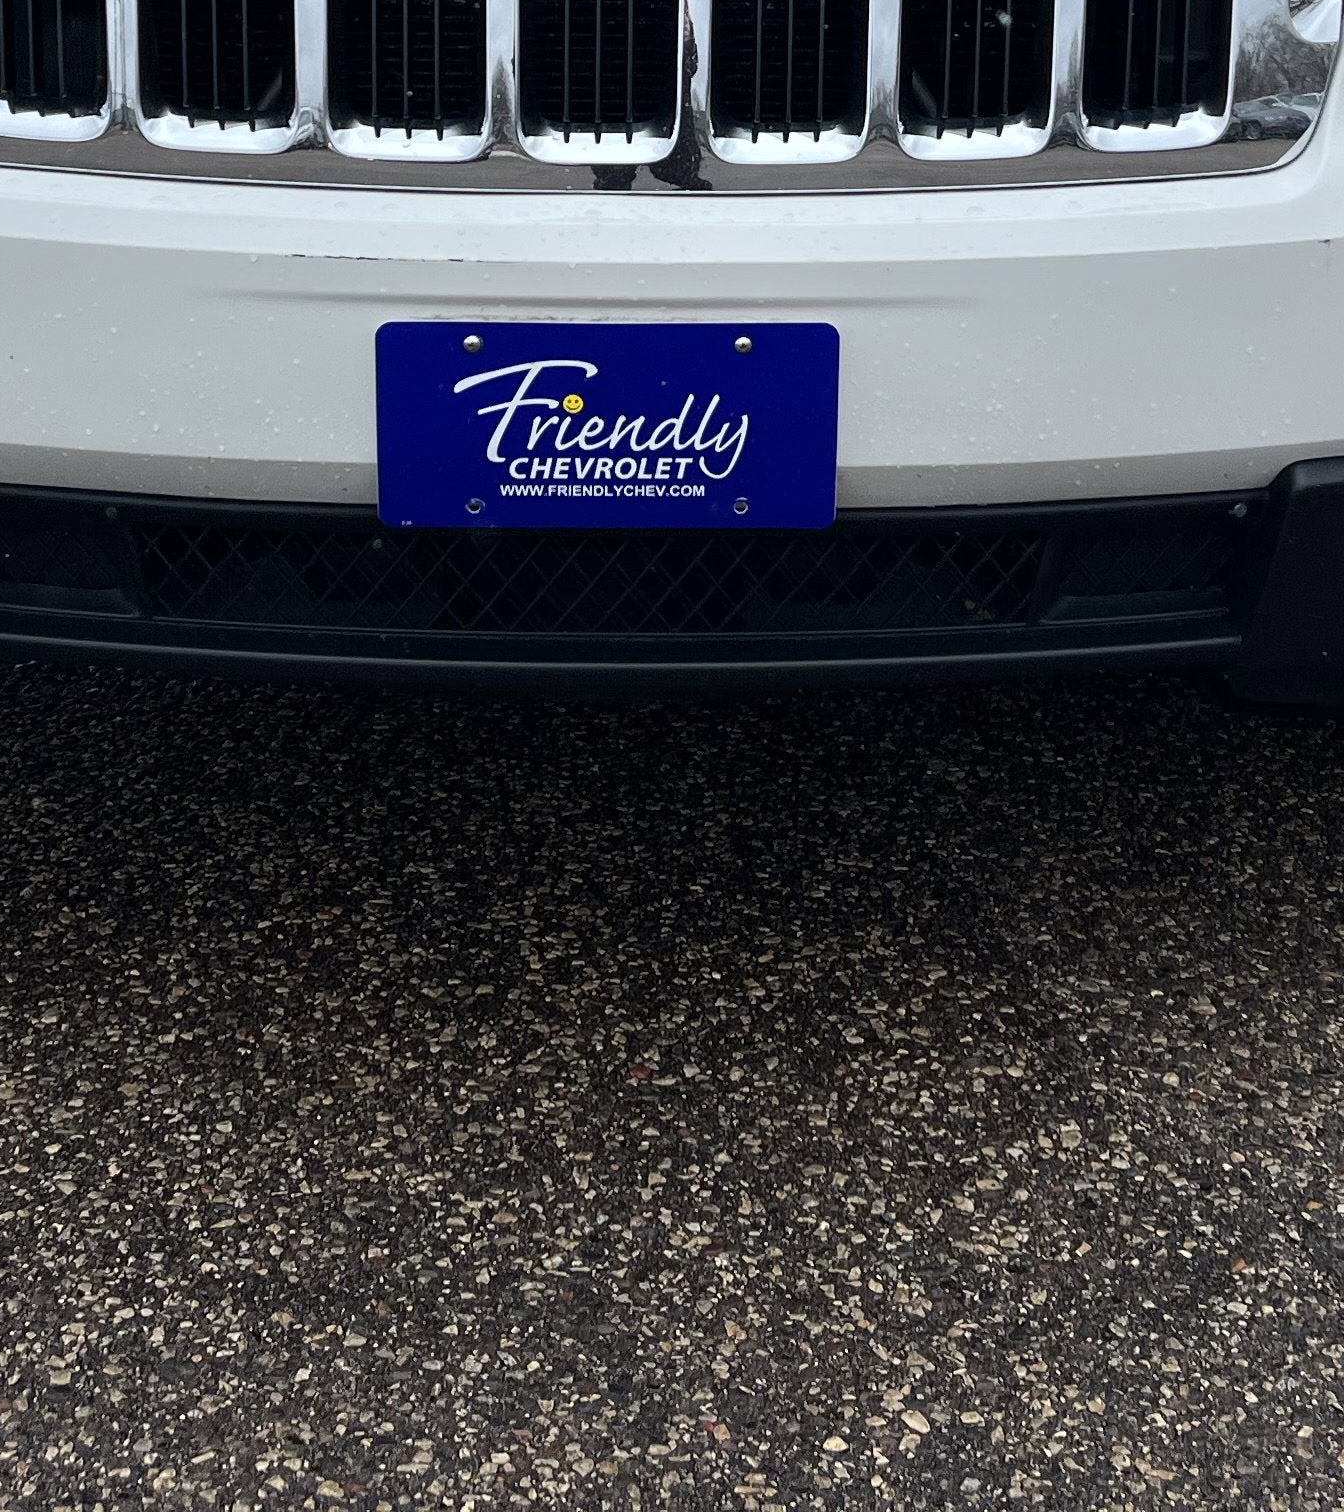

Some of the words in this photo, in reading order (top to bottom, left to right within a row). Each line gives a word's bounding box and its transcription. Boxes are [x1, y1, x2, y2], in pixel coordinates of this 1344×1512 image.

[454, 359, 749, 479] Friendly
[509, 457, 694, 480] CHEVROLET
[500, 484, 705, 497] WWW.FRIENDLYCHEV.COM
